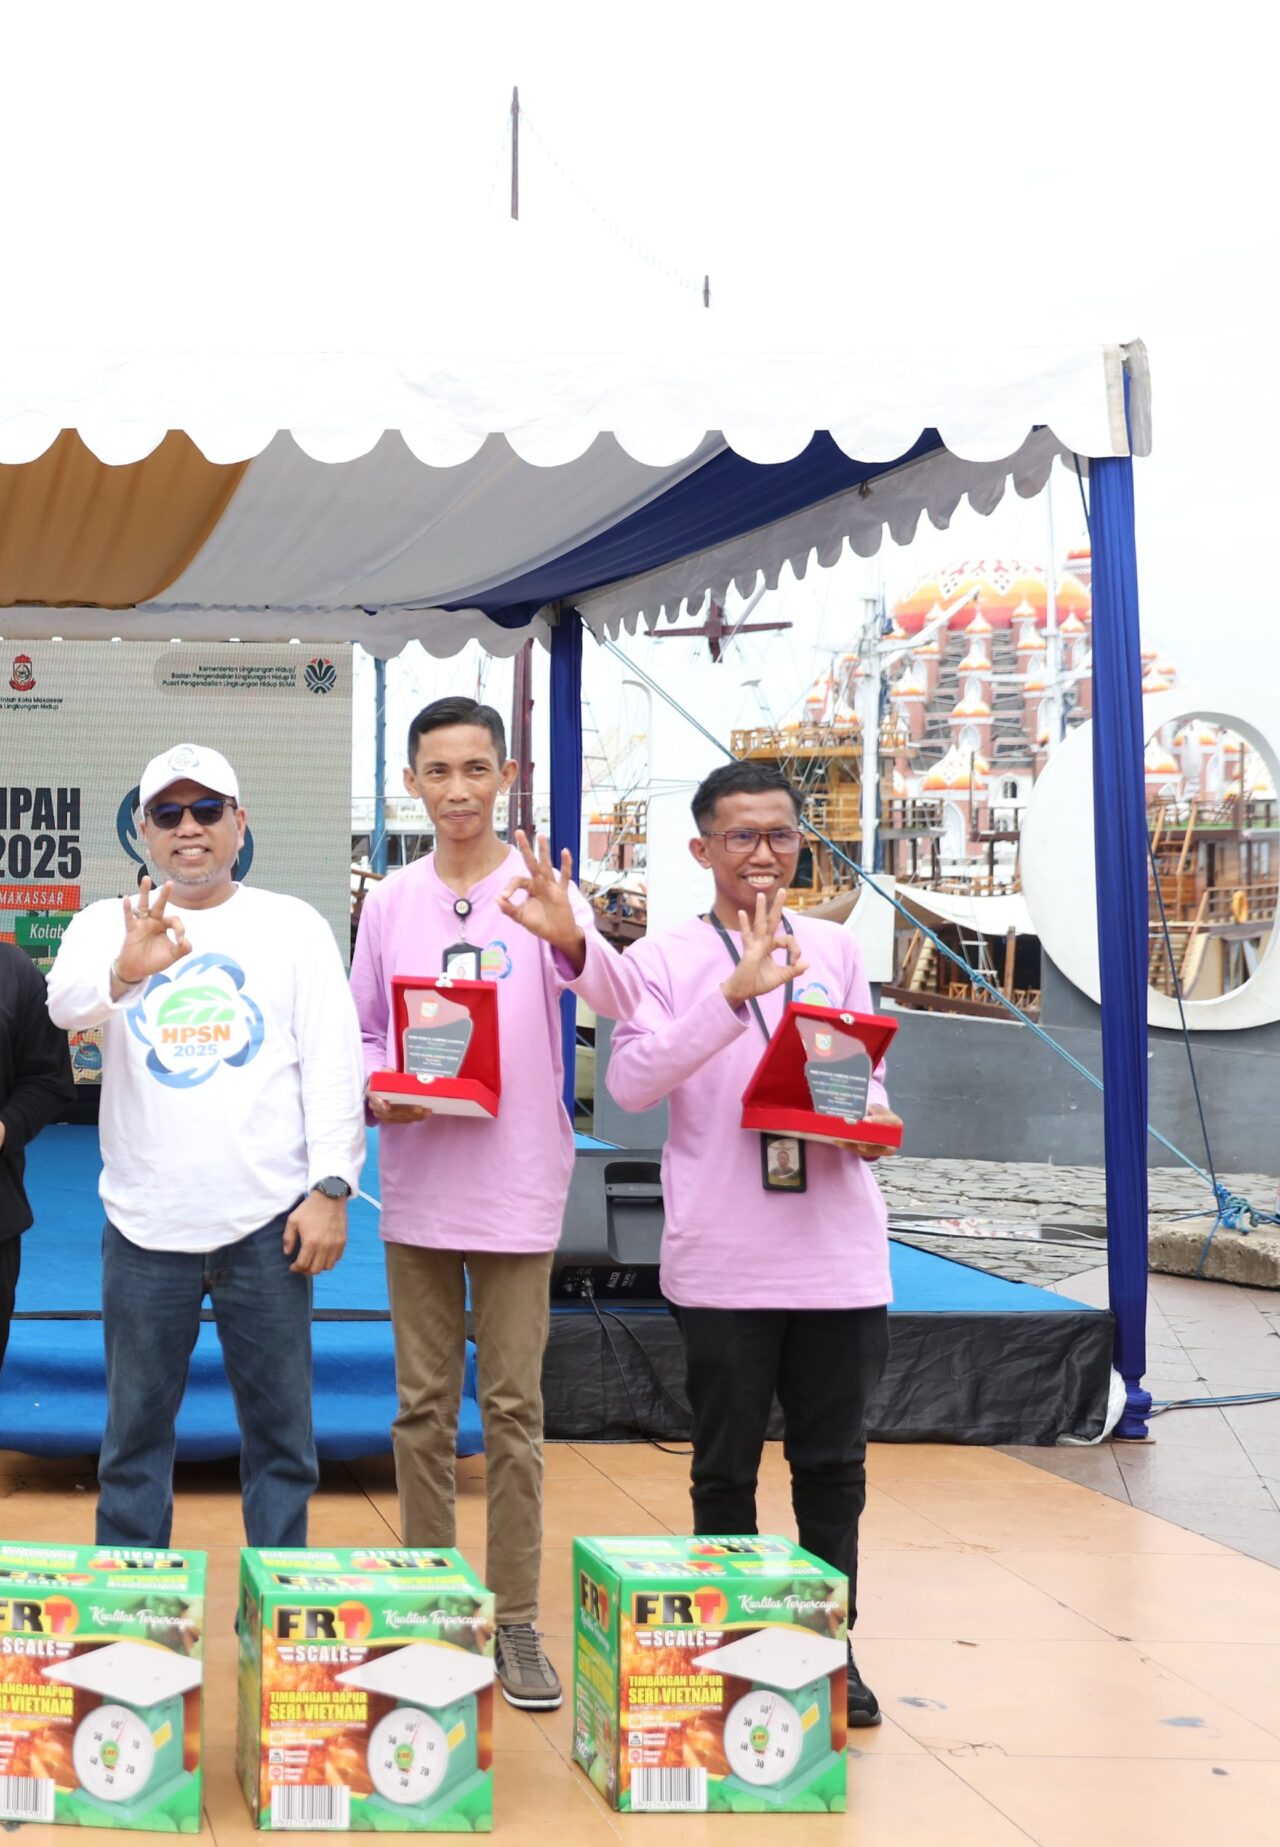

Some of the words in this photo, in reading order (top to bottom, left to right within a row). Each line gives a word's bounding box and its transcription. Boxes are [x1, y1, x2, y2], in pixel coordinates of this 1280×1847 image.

[4, 703, 39, 711] Lingkungan
[161, 1024, 231, 1045] HPSN
[173, 1044, 218, 1057] 2025
[634, 1592, 726, 1625] FRT
[737, 1594, 782, 1612] Kualitas
[89, 1605, 134, 1626] Kualitas
[276, 1606, 366, 1640] FRT
[382, 1609, 427, 1629] Kualitas
[2, 1637, 57, 1656] SCALE
[653, 1629, 705, 1647] SCALE
[295, 1646, 351, 1663] SCALE
[628, 1675, 687, 1687] TIMBANGAN
[688, 1675, 723, 1687] DAPUR
[38, 1685, 74, 1699] DAPUR
[270, 1691, 331, 1703] TIMBANGAN
[332, 1692, 368, 1704] DAPUR
[628, 1687, 660, 1704] SERI
[661, 1687, 723, 1704] VIETNAM
[10, 1696, 75, 1716] VIETNAM
[270, 1703, 303, 1720] SERI
[304, 1704, 368, 1721] VIETNAM
